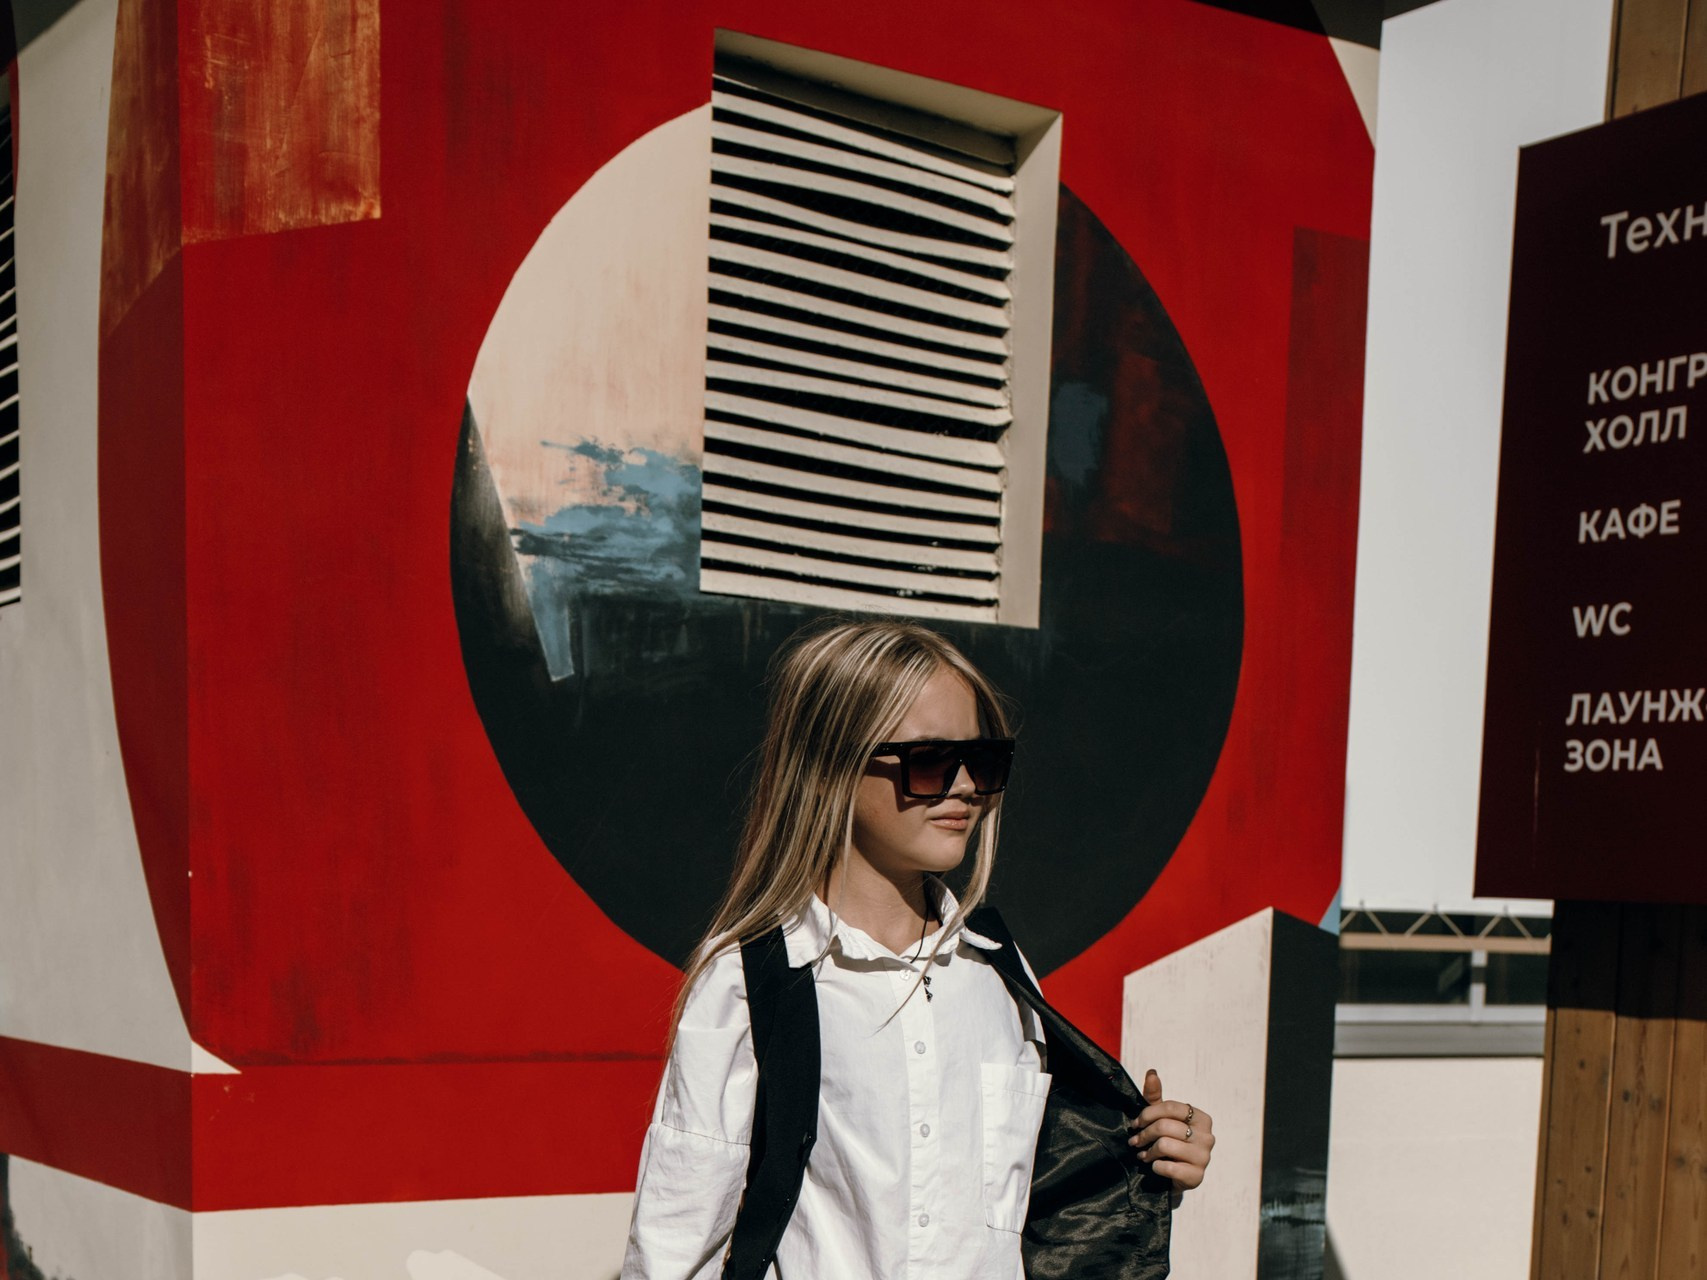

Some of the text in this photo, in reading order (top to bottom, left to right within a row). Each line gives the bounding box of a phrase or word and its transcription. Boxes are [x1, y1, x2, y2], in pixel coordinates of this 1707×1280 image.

[1601, 201, 1707, 259] Техн
[1587, 353, 1707, 405] КОНГР
[1582, 405, 1687, 453] ХОЛЛ
[1578, 500, 1681, 544] КАФЕ
[1572, 602, 1632, 638] WC
[1565, 688, 1707, 726] ЛАУНЖ
[1563, 738, 1663, 772] ЗОНА
